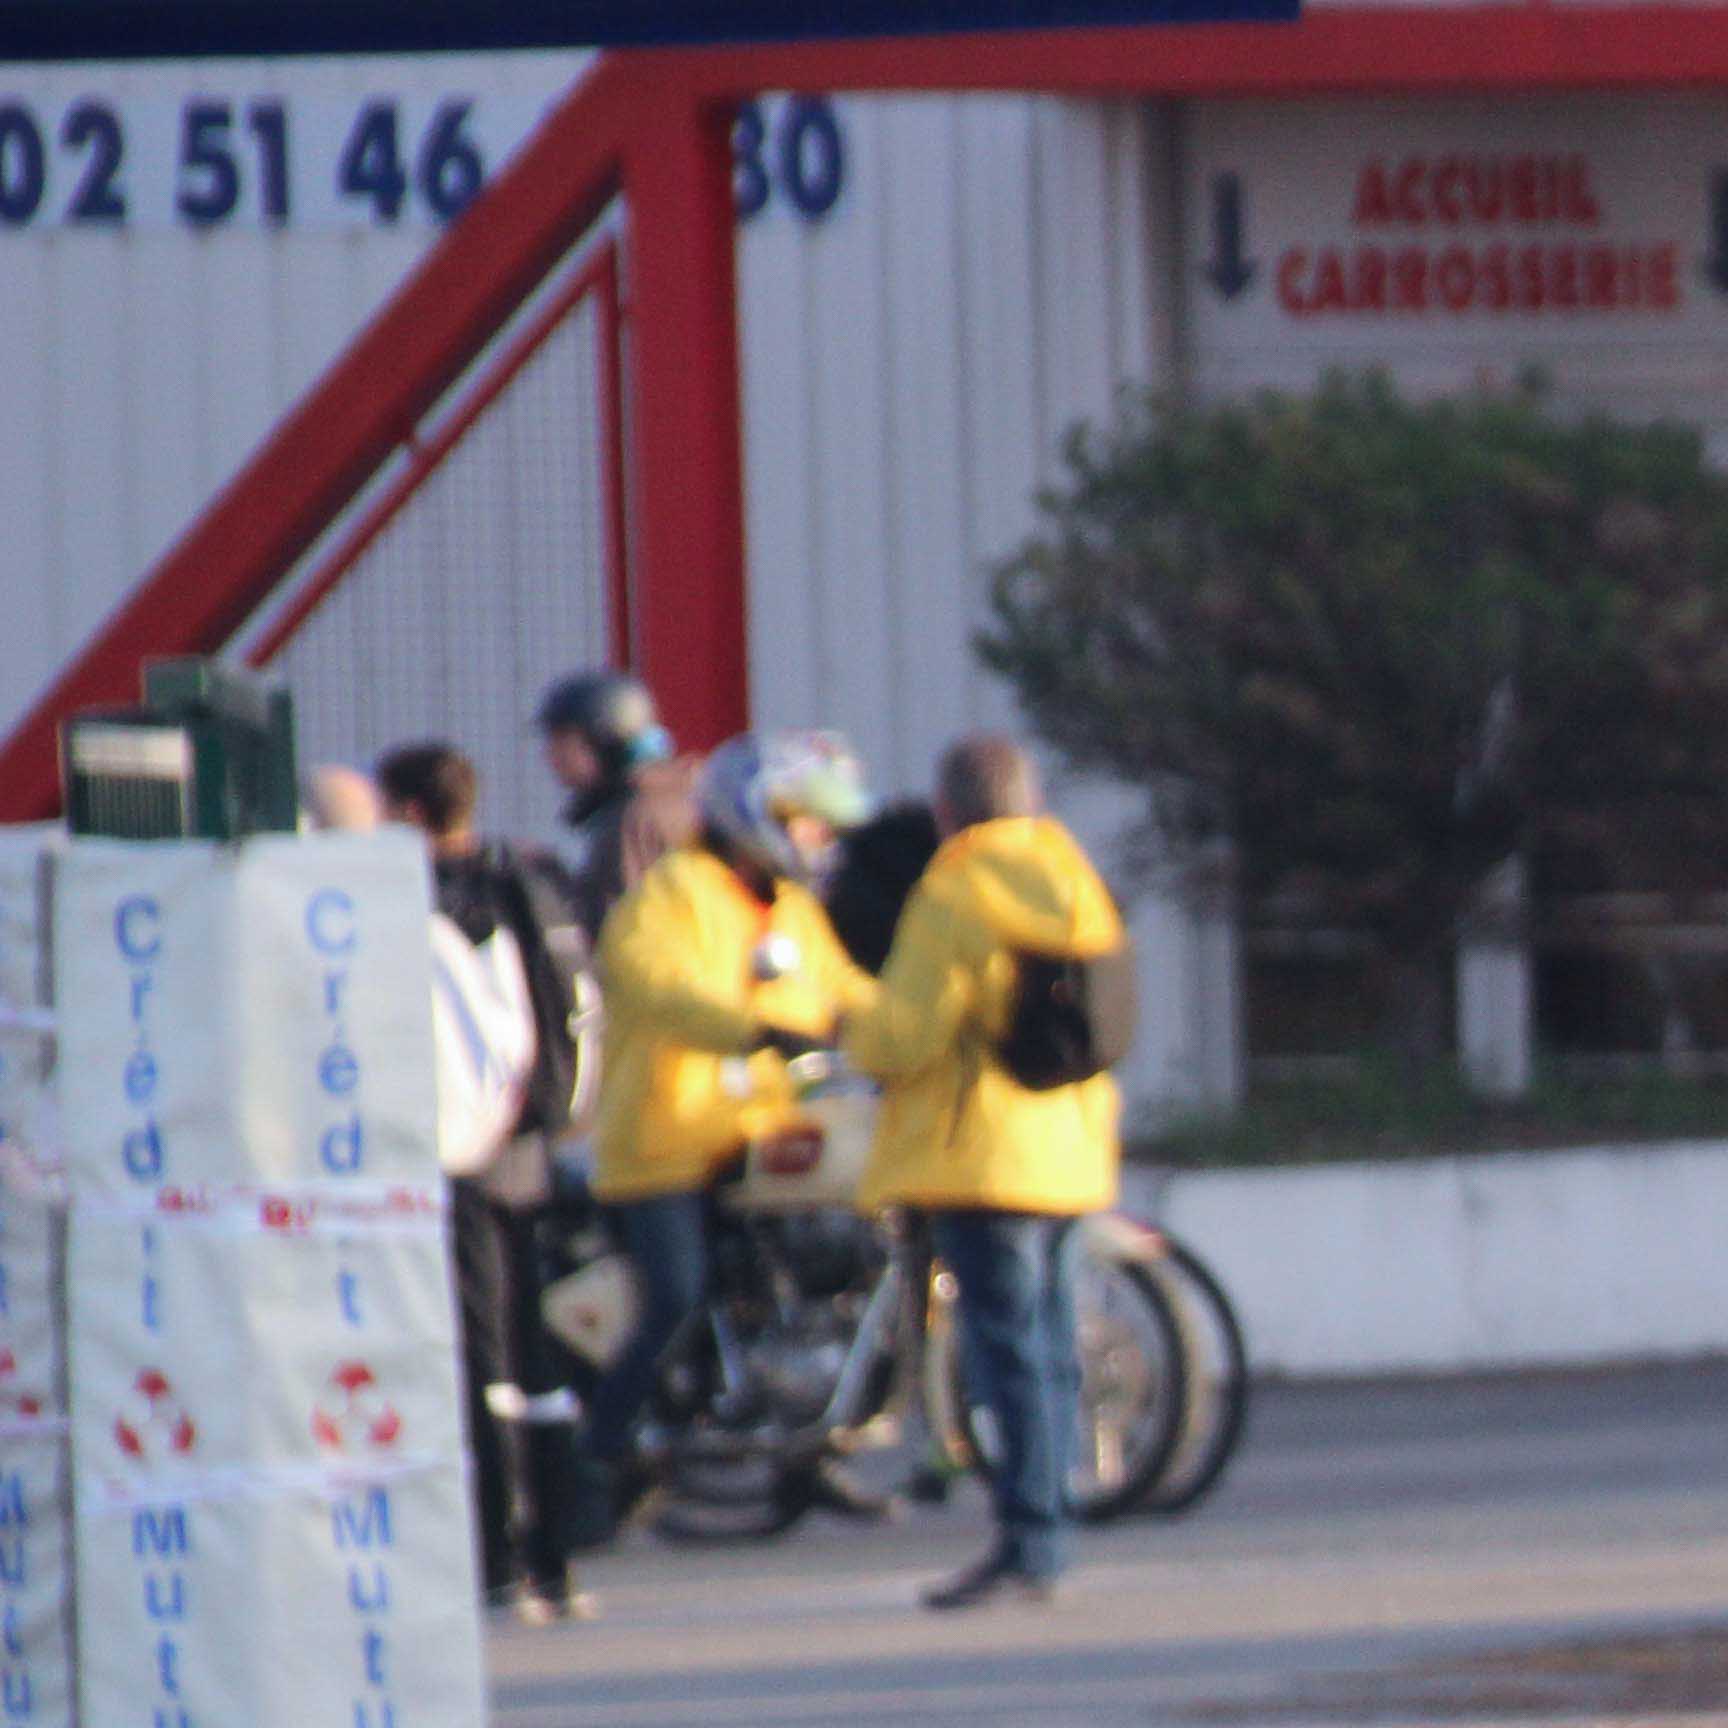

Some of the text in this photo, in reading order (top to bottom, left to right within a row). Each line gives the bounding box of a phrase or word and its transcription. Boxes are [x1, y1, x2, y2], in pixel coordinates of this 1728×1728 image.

[0, 97, 127, 226] 02
[177, 96, 289, 226] 51
[335, 96, 484, 222] 46
[1350, 151, 1600, 228] ACCUEIL
[1276, 241, 1682, 317] CARROSSERIE
